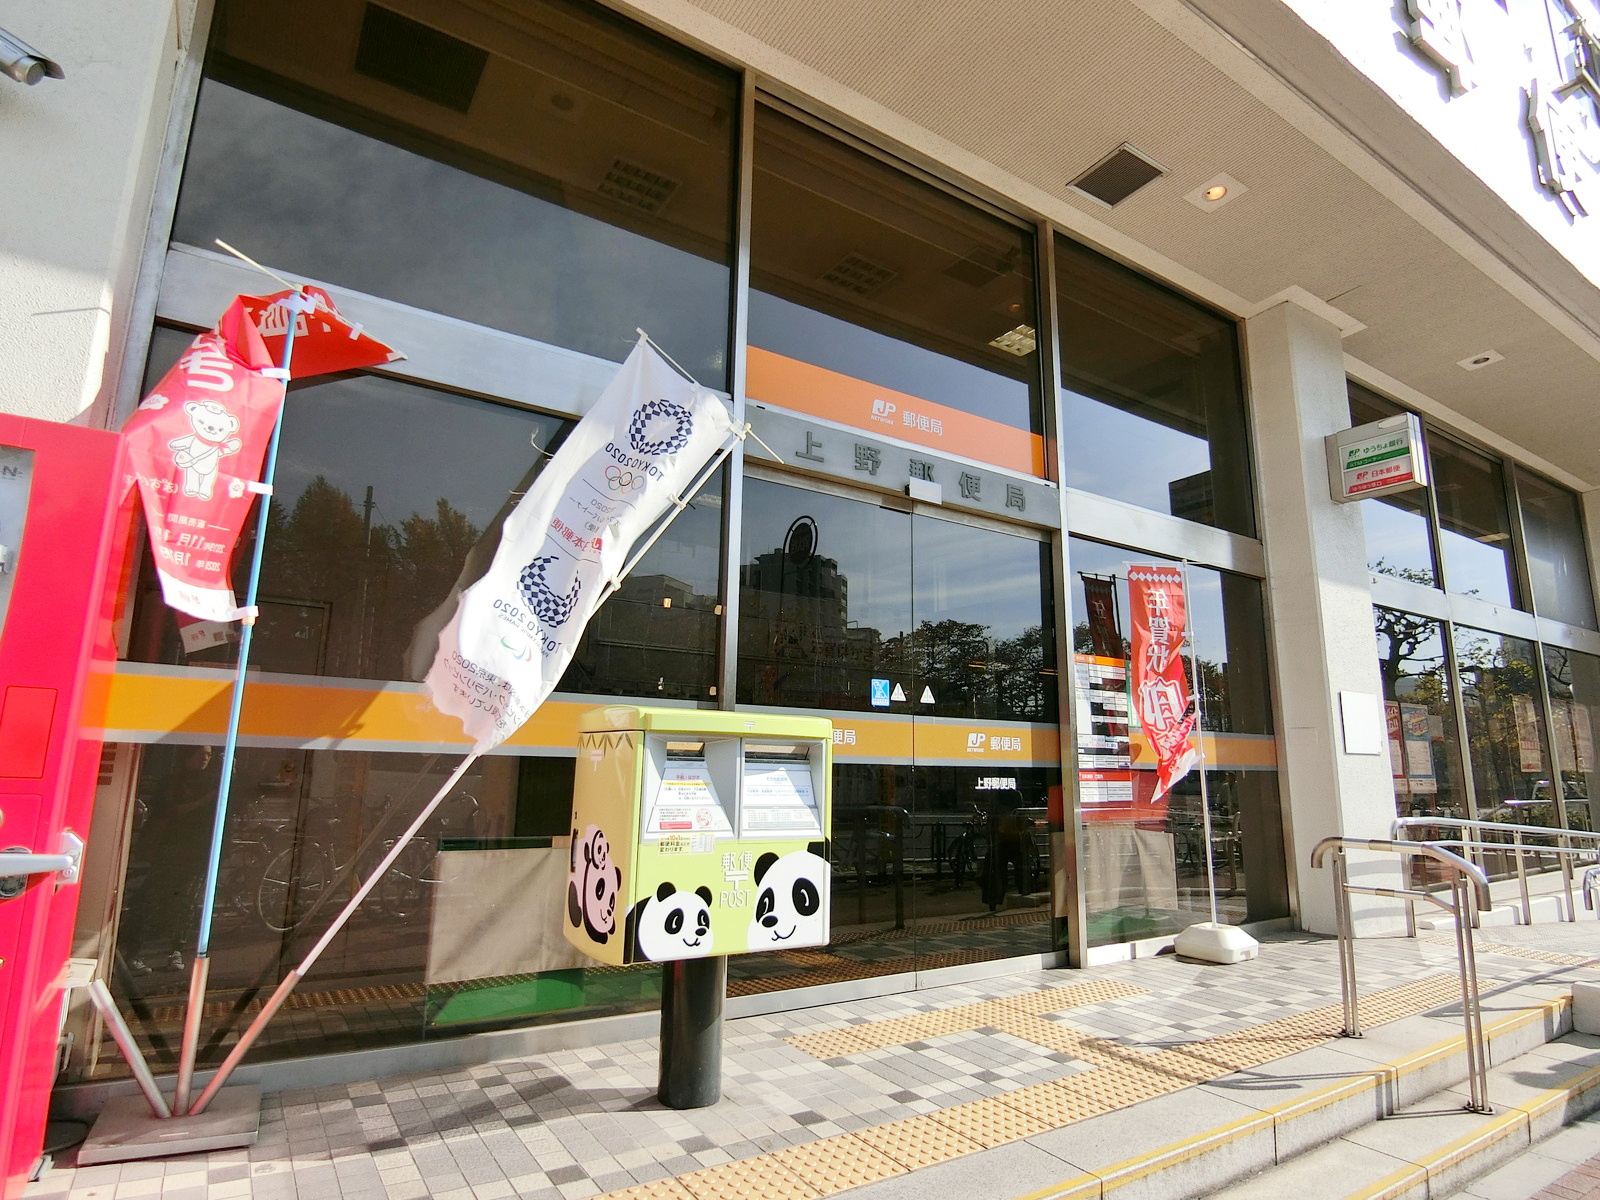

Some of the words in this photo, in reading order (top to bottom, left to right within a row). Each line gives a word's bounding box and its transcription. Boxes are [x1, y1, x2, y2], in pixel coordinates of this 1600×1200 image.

[870, 415, 894, 425] NETWORK
[872, 399, 896, 417] JP
[903, 411, 943, 436] 郵便局
[1363, 438, 1403, 454] ゆうちょ銀行
[795, 430, 1027, 512] 上野郵便局
[1371, 465, 1401, 478] 日本郵便
[832, 729, 857, 746] 便局
[967, 733, 986, 748] JP
[990, 736, 1021, 752] 郵便局
[974, 777, 1017, 790] 上野郵便局
[721, 851, 752, 872] 郵便
[719, 890, 751, 908] POST
